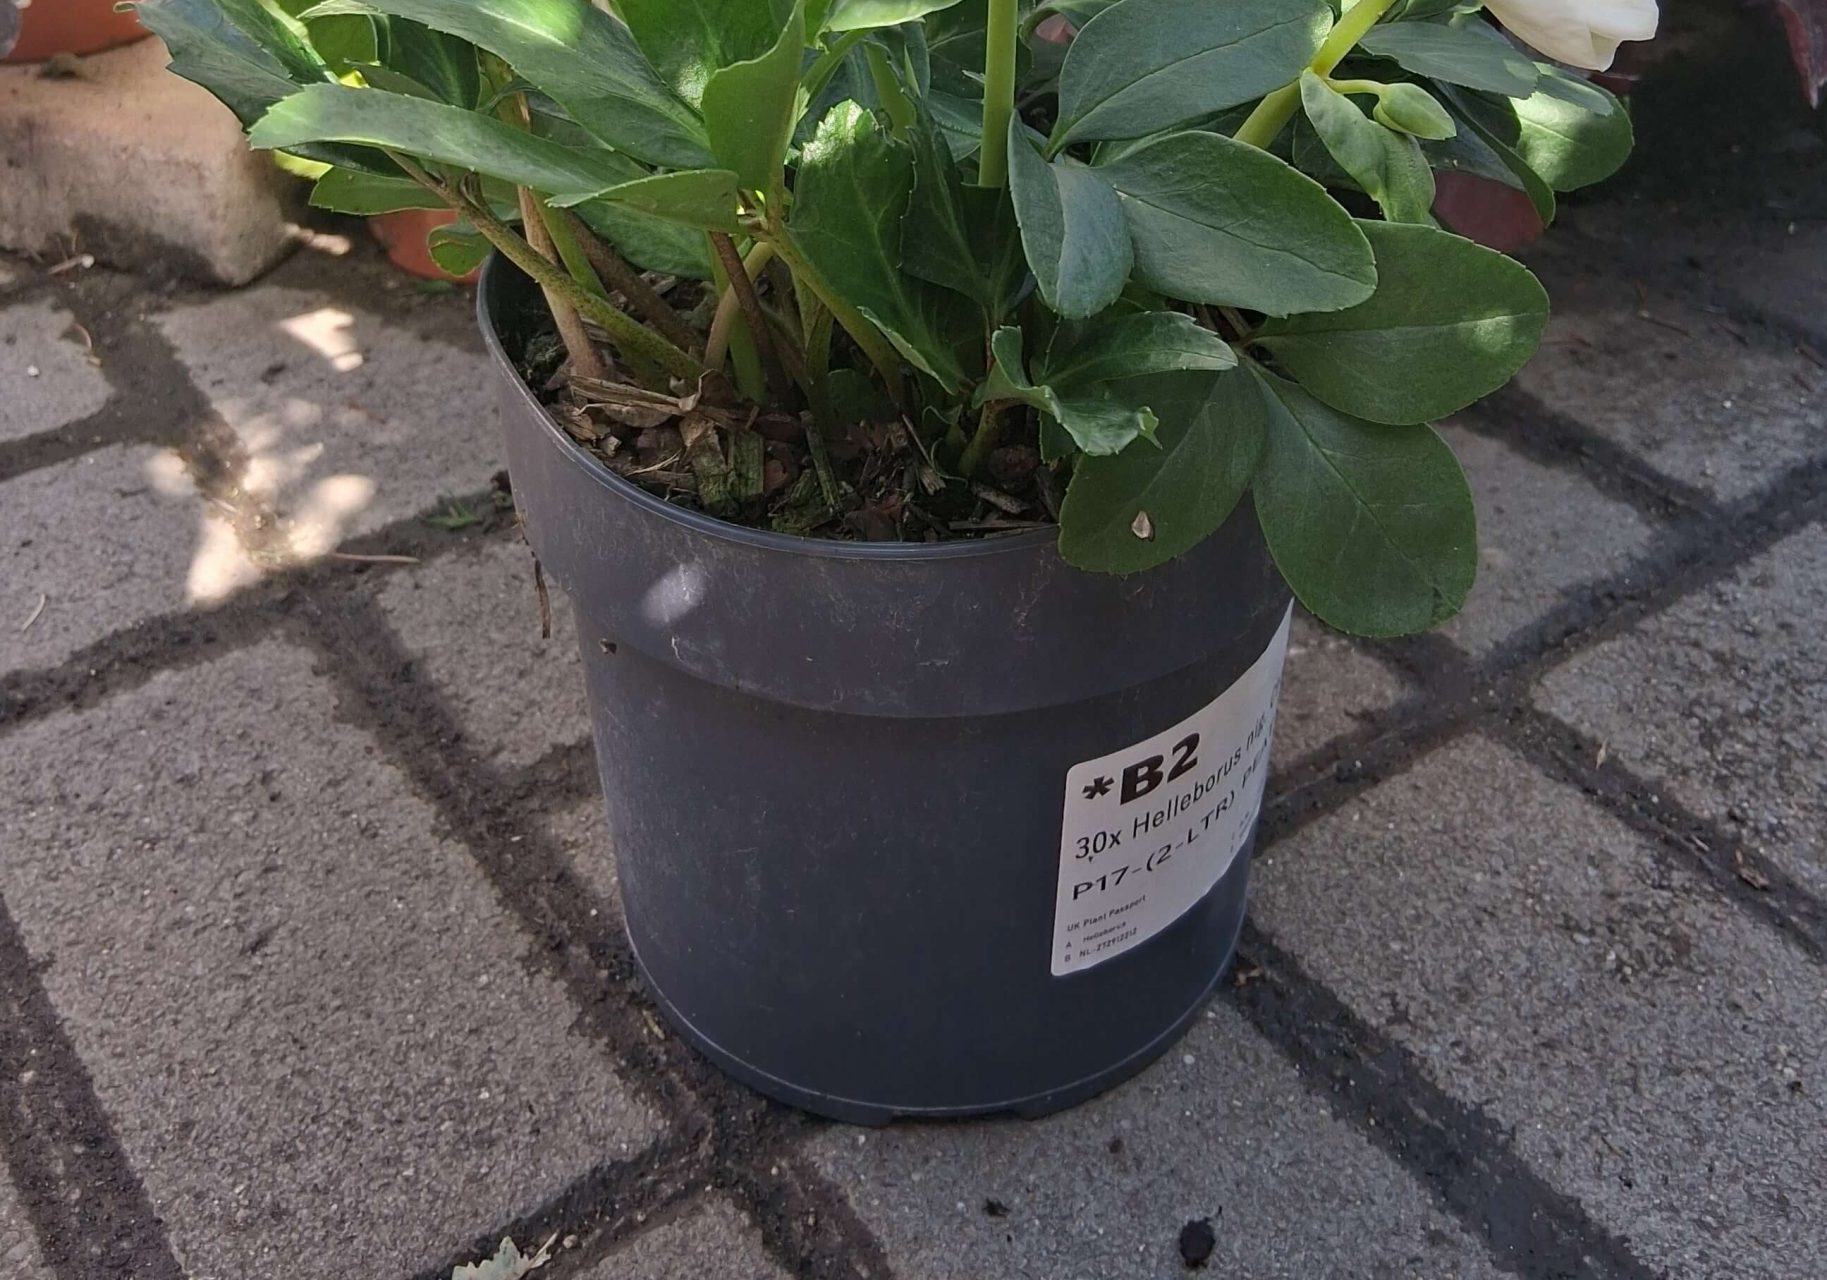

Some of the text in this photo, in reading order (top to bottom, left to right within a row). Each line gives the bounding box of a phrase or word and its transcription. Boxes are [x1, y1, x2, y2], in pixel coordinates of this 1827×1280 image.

[1075, 829, 1122, 860] 30x
[1132, 746, 1242, 839] Helleborus
[1066, 893, 1146, 933] UK Plant Passport
